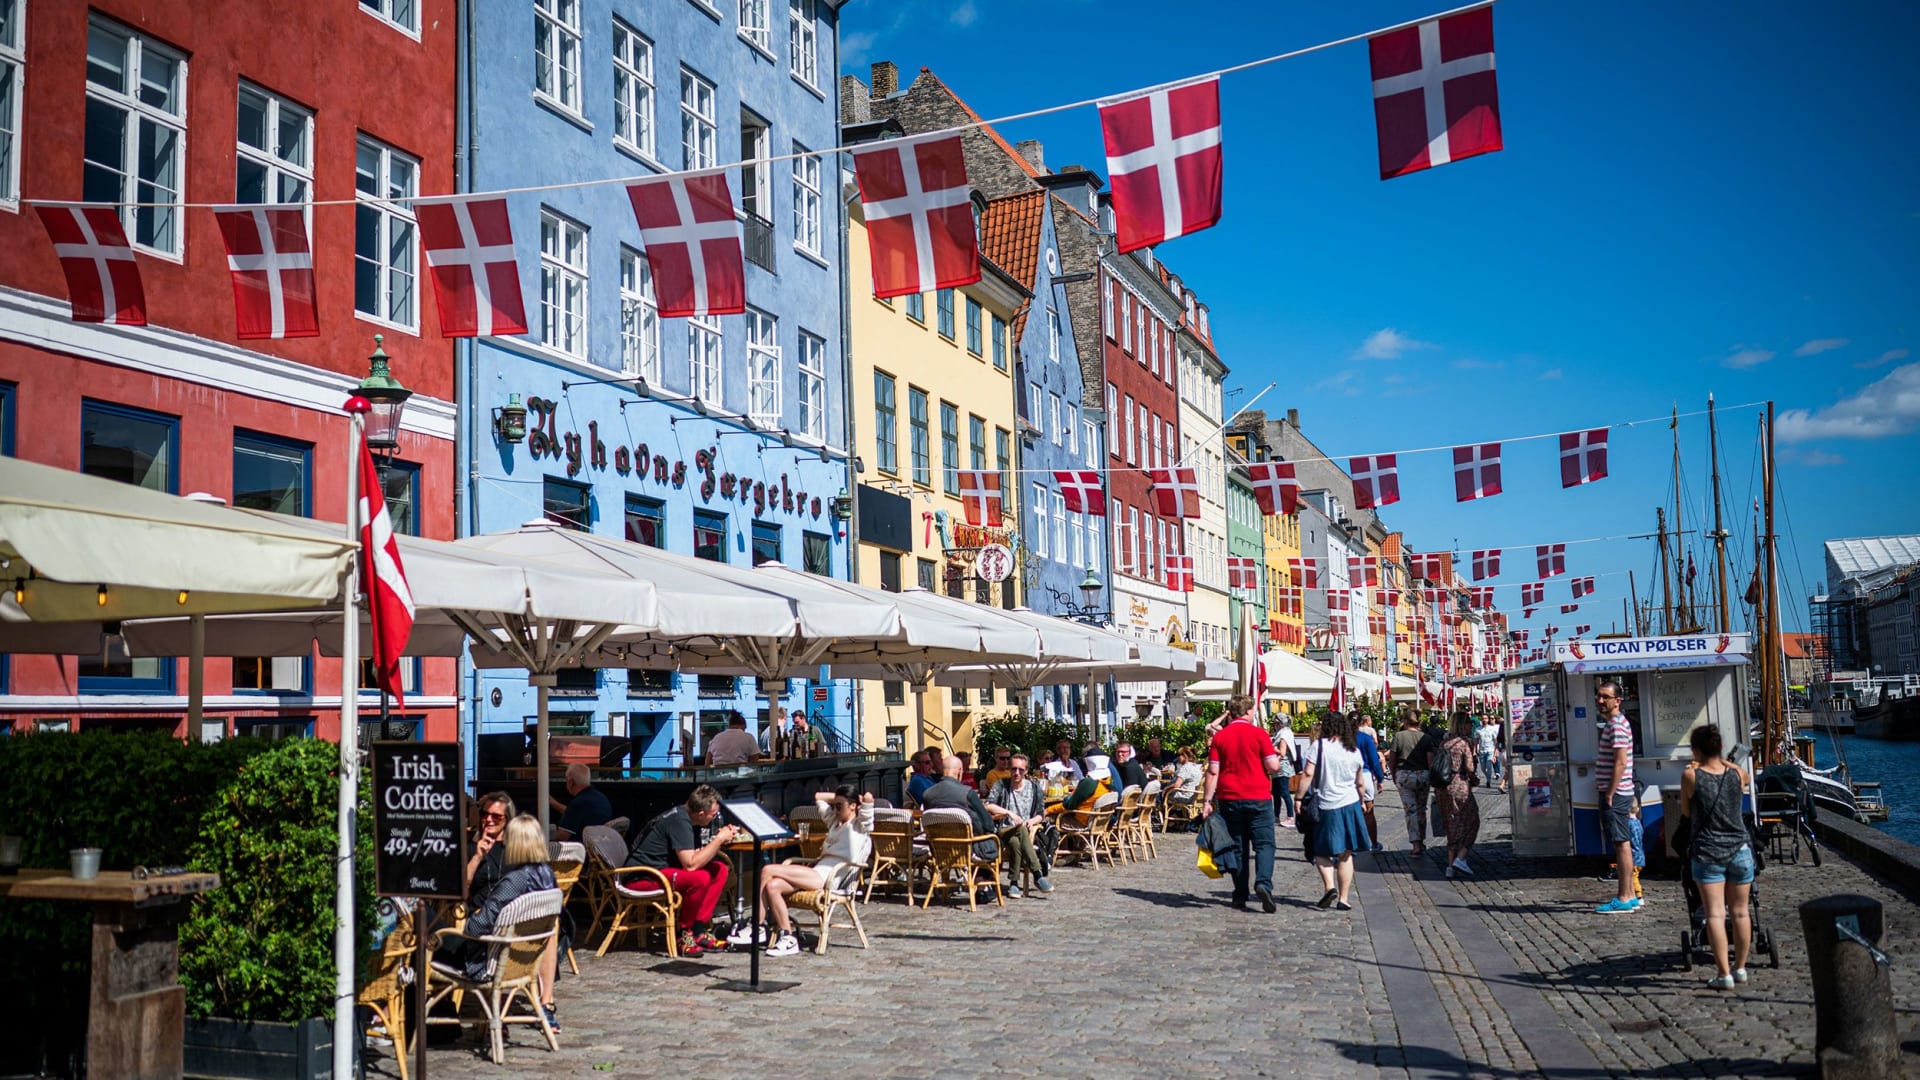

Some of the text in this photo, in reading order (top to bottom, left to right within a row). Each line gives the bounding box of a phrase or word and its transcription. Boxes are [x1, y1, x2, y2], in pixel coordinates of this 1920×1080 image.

[527, 396, 822, 518] Nyhavns Færgekro
[1592, 639, 1707, 655] TICAN PØLSER
[392, 754, 444, 780] Irish
[384, 784, 455, 811] Coffee
[390, 828, 452, 838] Single Double
